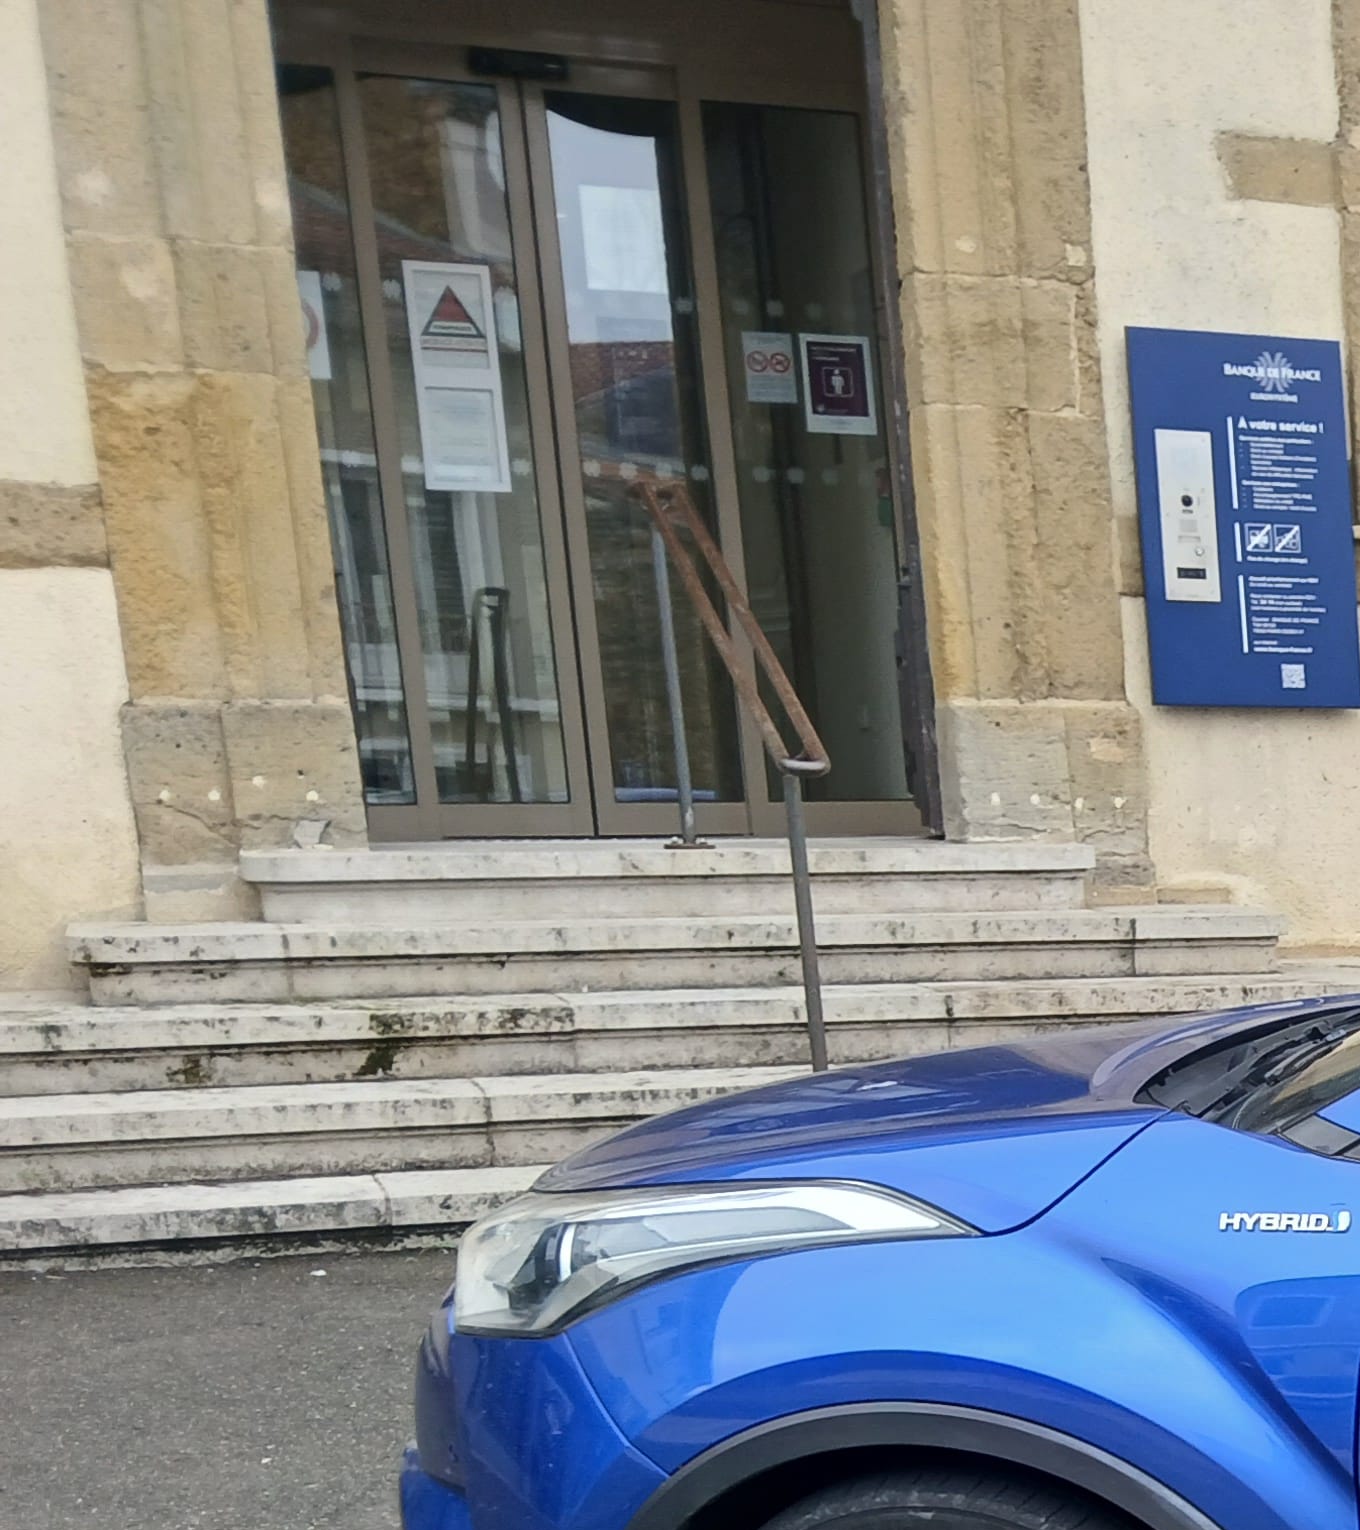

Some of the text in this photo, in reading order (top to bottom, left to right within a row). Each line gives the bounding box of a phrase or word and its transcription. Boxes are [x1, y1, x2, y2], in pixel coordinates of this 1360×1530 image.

[1280, 367, 1321, 382] FRANCE
[1248, 420, 1277, 431] votre
[1279, 421, 1318, 433] service
[1219, 1212, 1329, 1232] HYBRID
